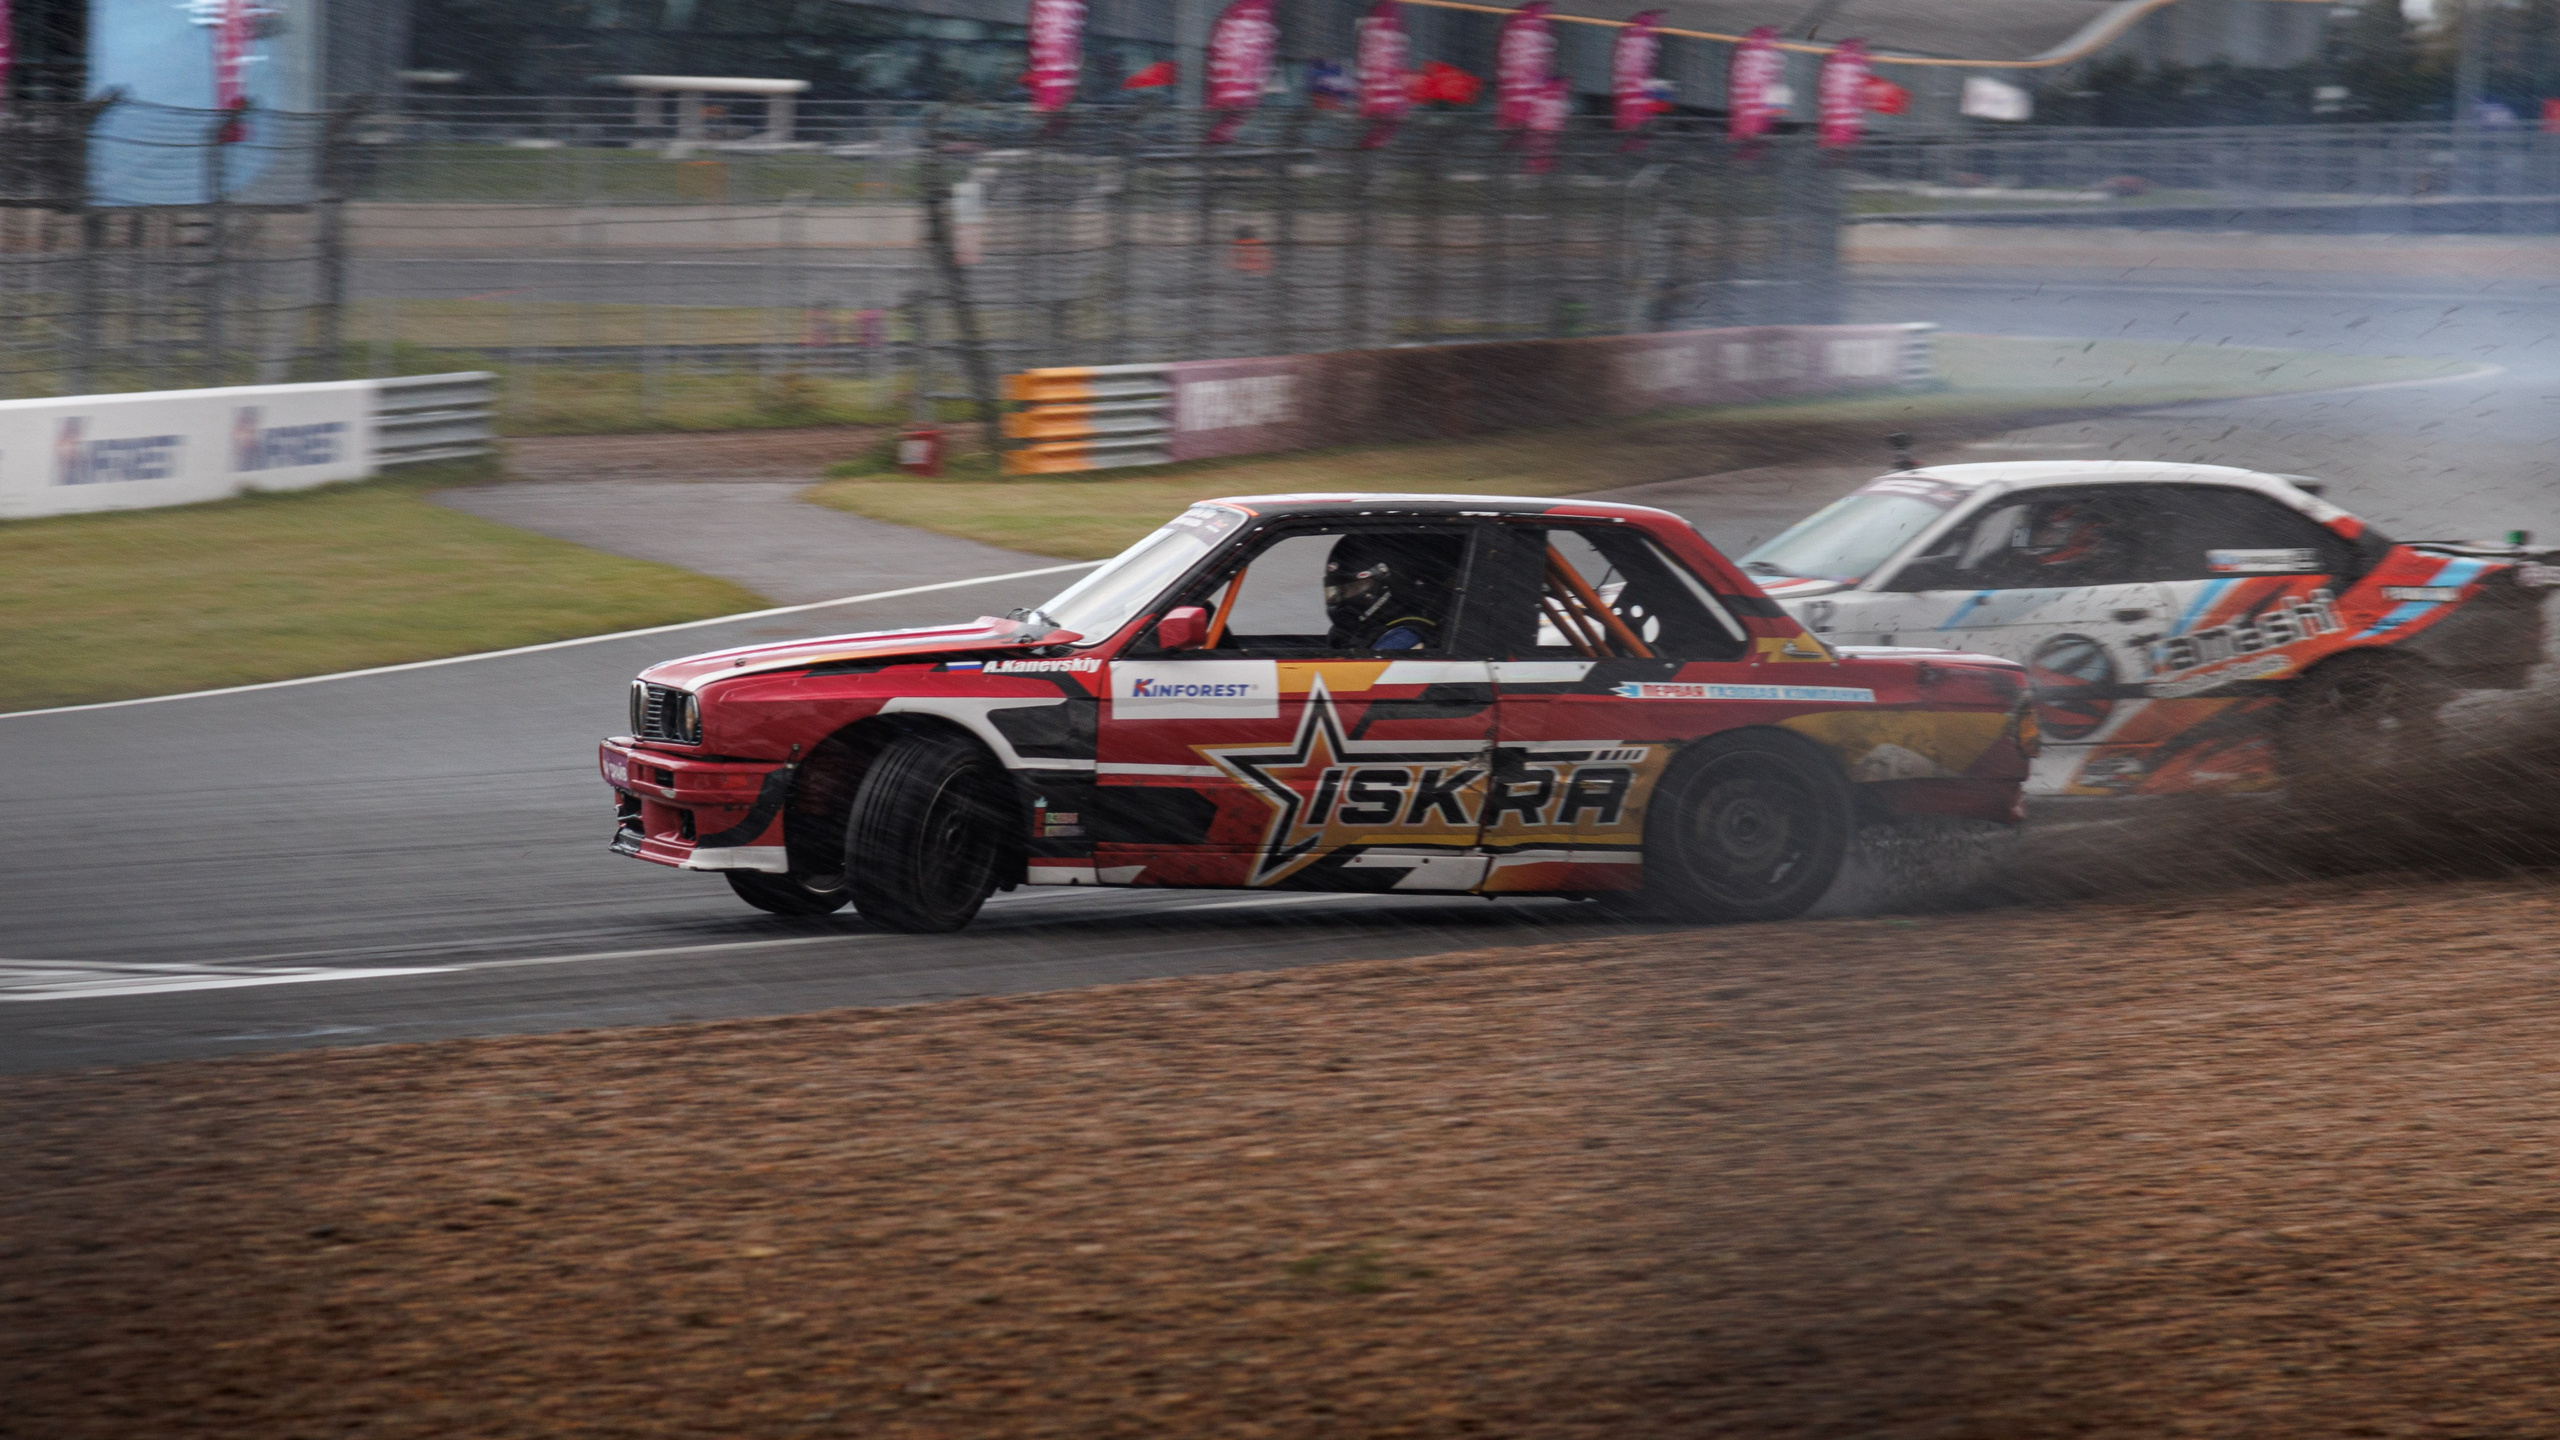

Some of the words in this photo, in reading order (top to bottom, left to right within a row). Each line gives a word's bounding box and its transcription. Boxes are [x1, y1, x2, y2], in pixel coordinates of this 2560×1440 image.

[982, 657, 1102, 673] A.Kanevskiy
[1132, 679, 1249, 697] KINFOREST
[1642, 684, 1704, 698] ПЕРВАЯ
[1304, 767, 1630, 826] ISKRA
